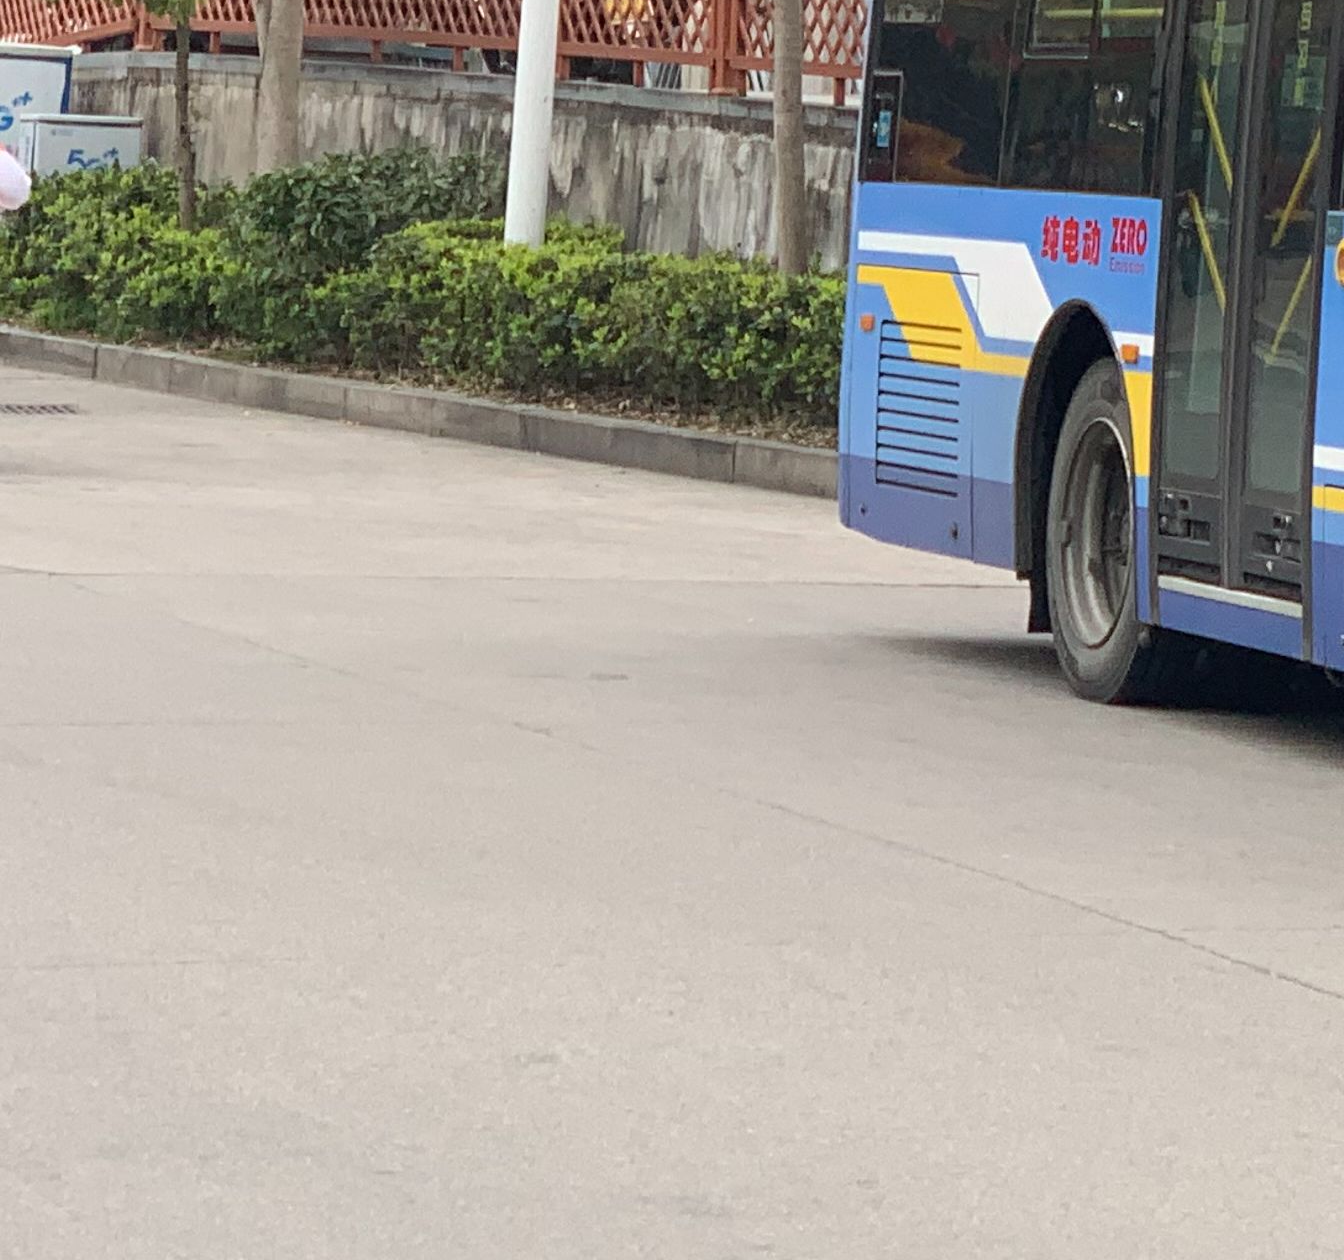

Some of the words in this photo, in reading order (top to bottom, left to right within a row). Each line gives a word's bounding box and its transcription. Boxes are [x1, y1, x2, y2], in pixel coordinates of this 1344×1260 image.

[1041, 216, 1102, 266] 纯电动
[1111, 217, 1148, 256] ZERO
